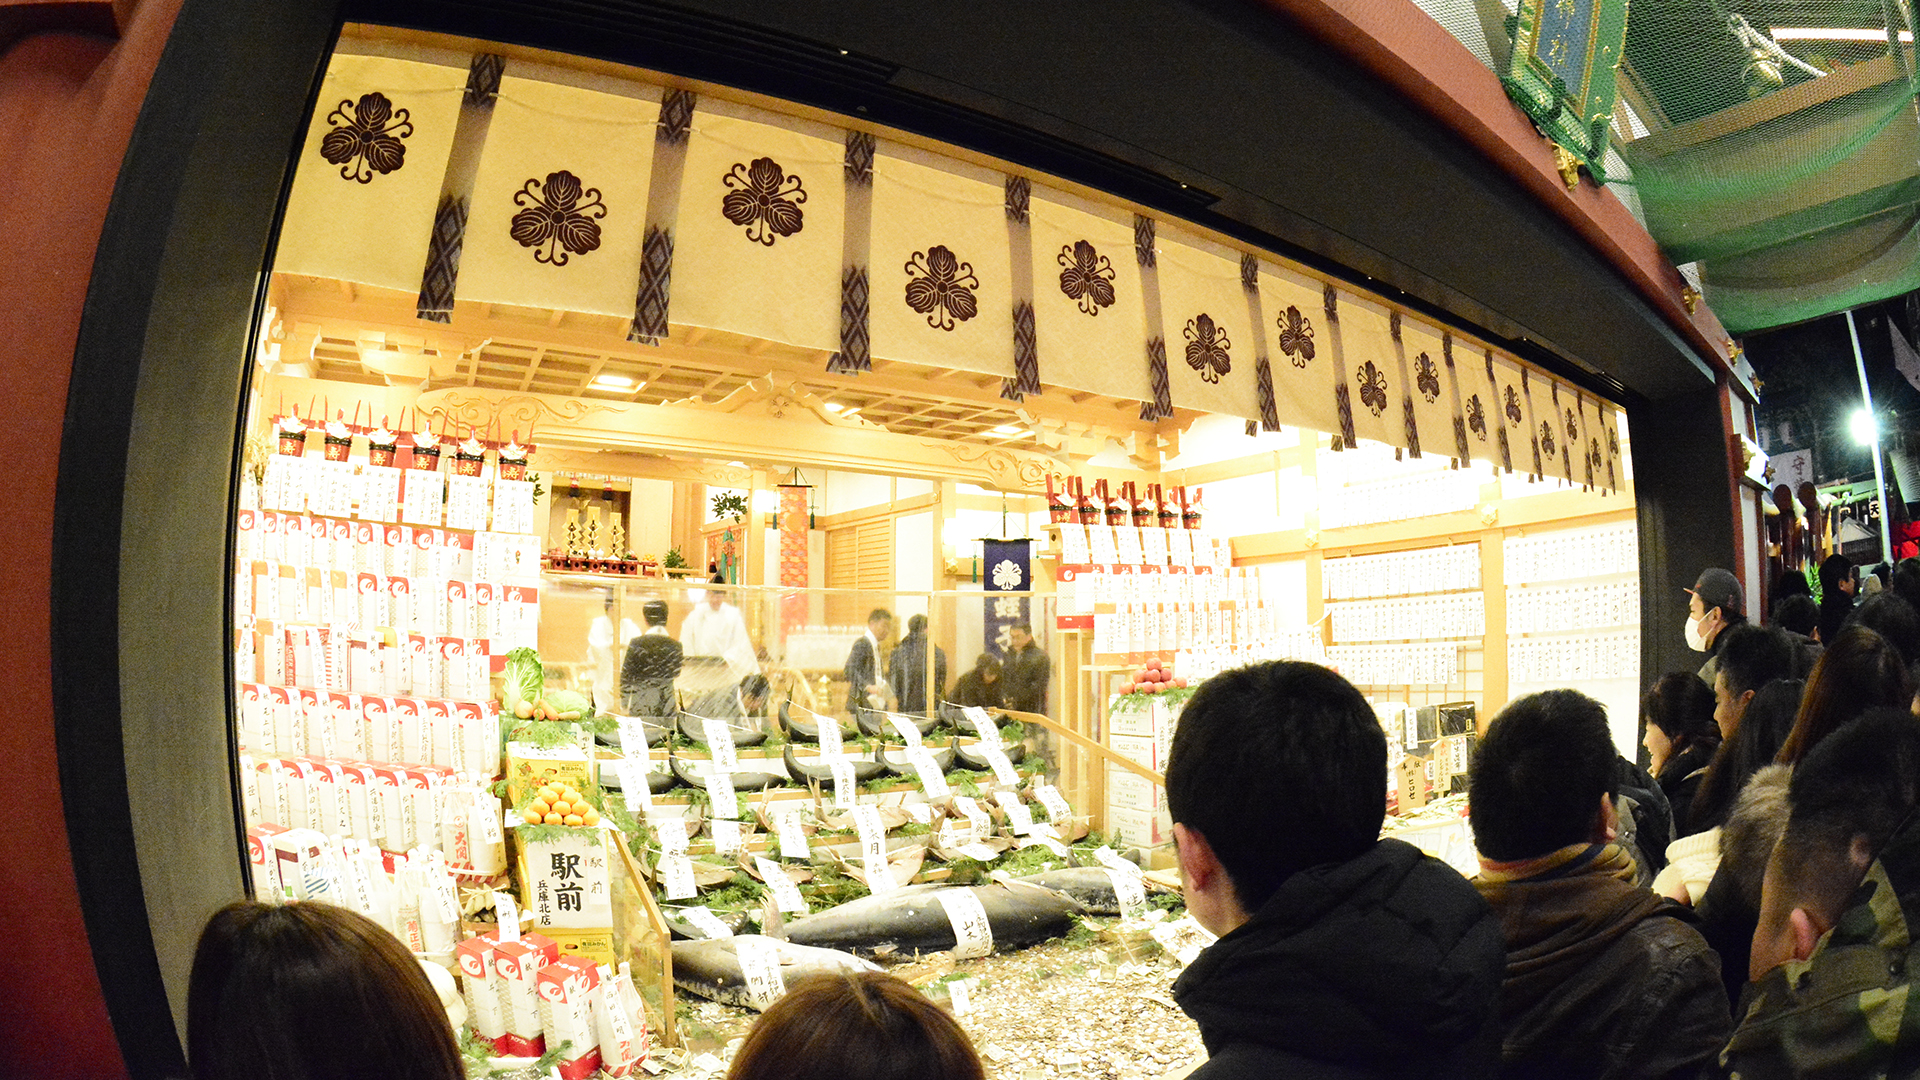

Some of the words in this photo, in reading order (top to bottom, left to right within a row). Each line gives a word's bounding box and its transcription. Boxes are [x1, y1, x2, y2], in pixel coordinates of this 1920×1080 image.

[550, 852, 584, 912] 駅前
[588, 855, 604, 895] 駅前
[536, 879, 551, 926] 兵庫北店
